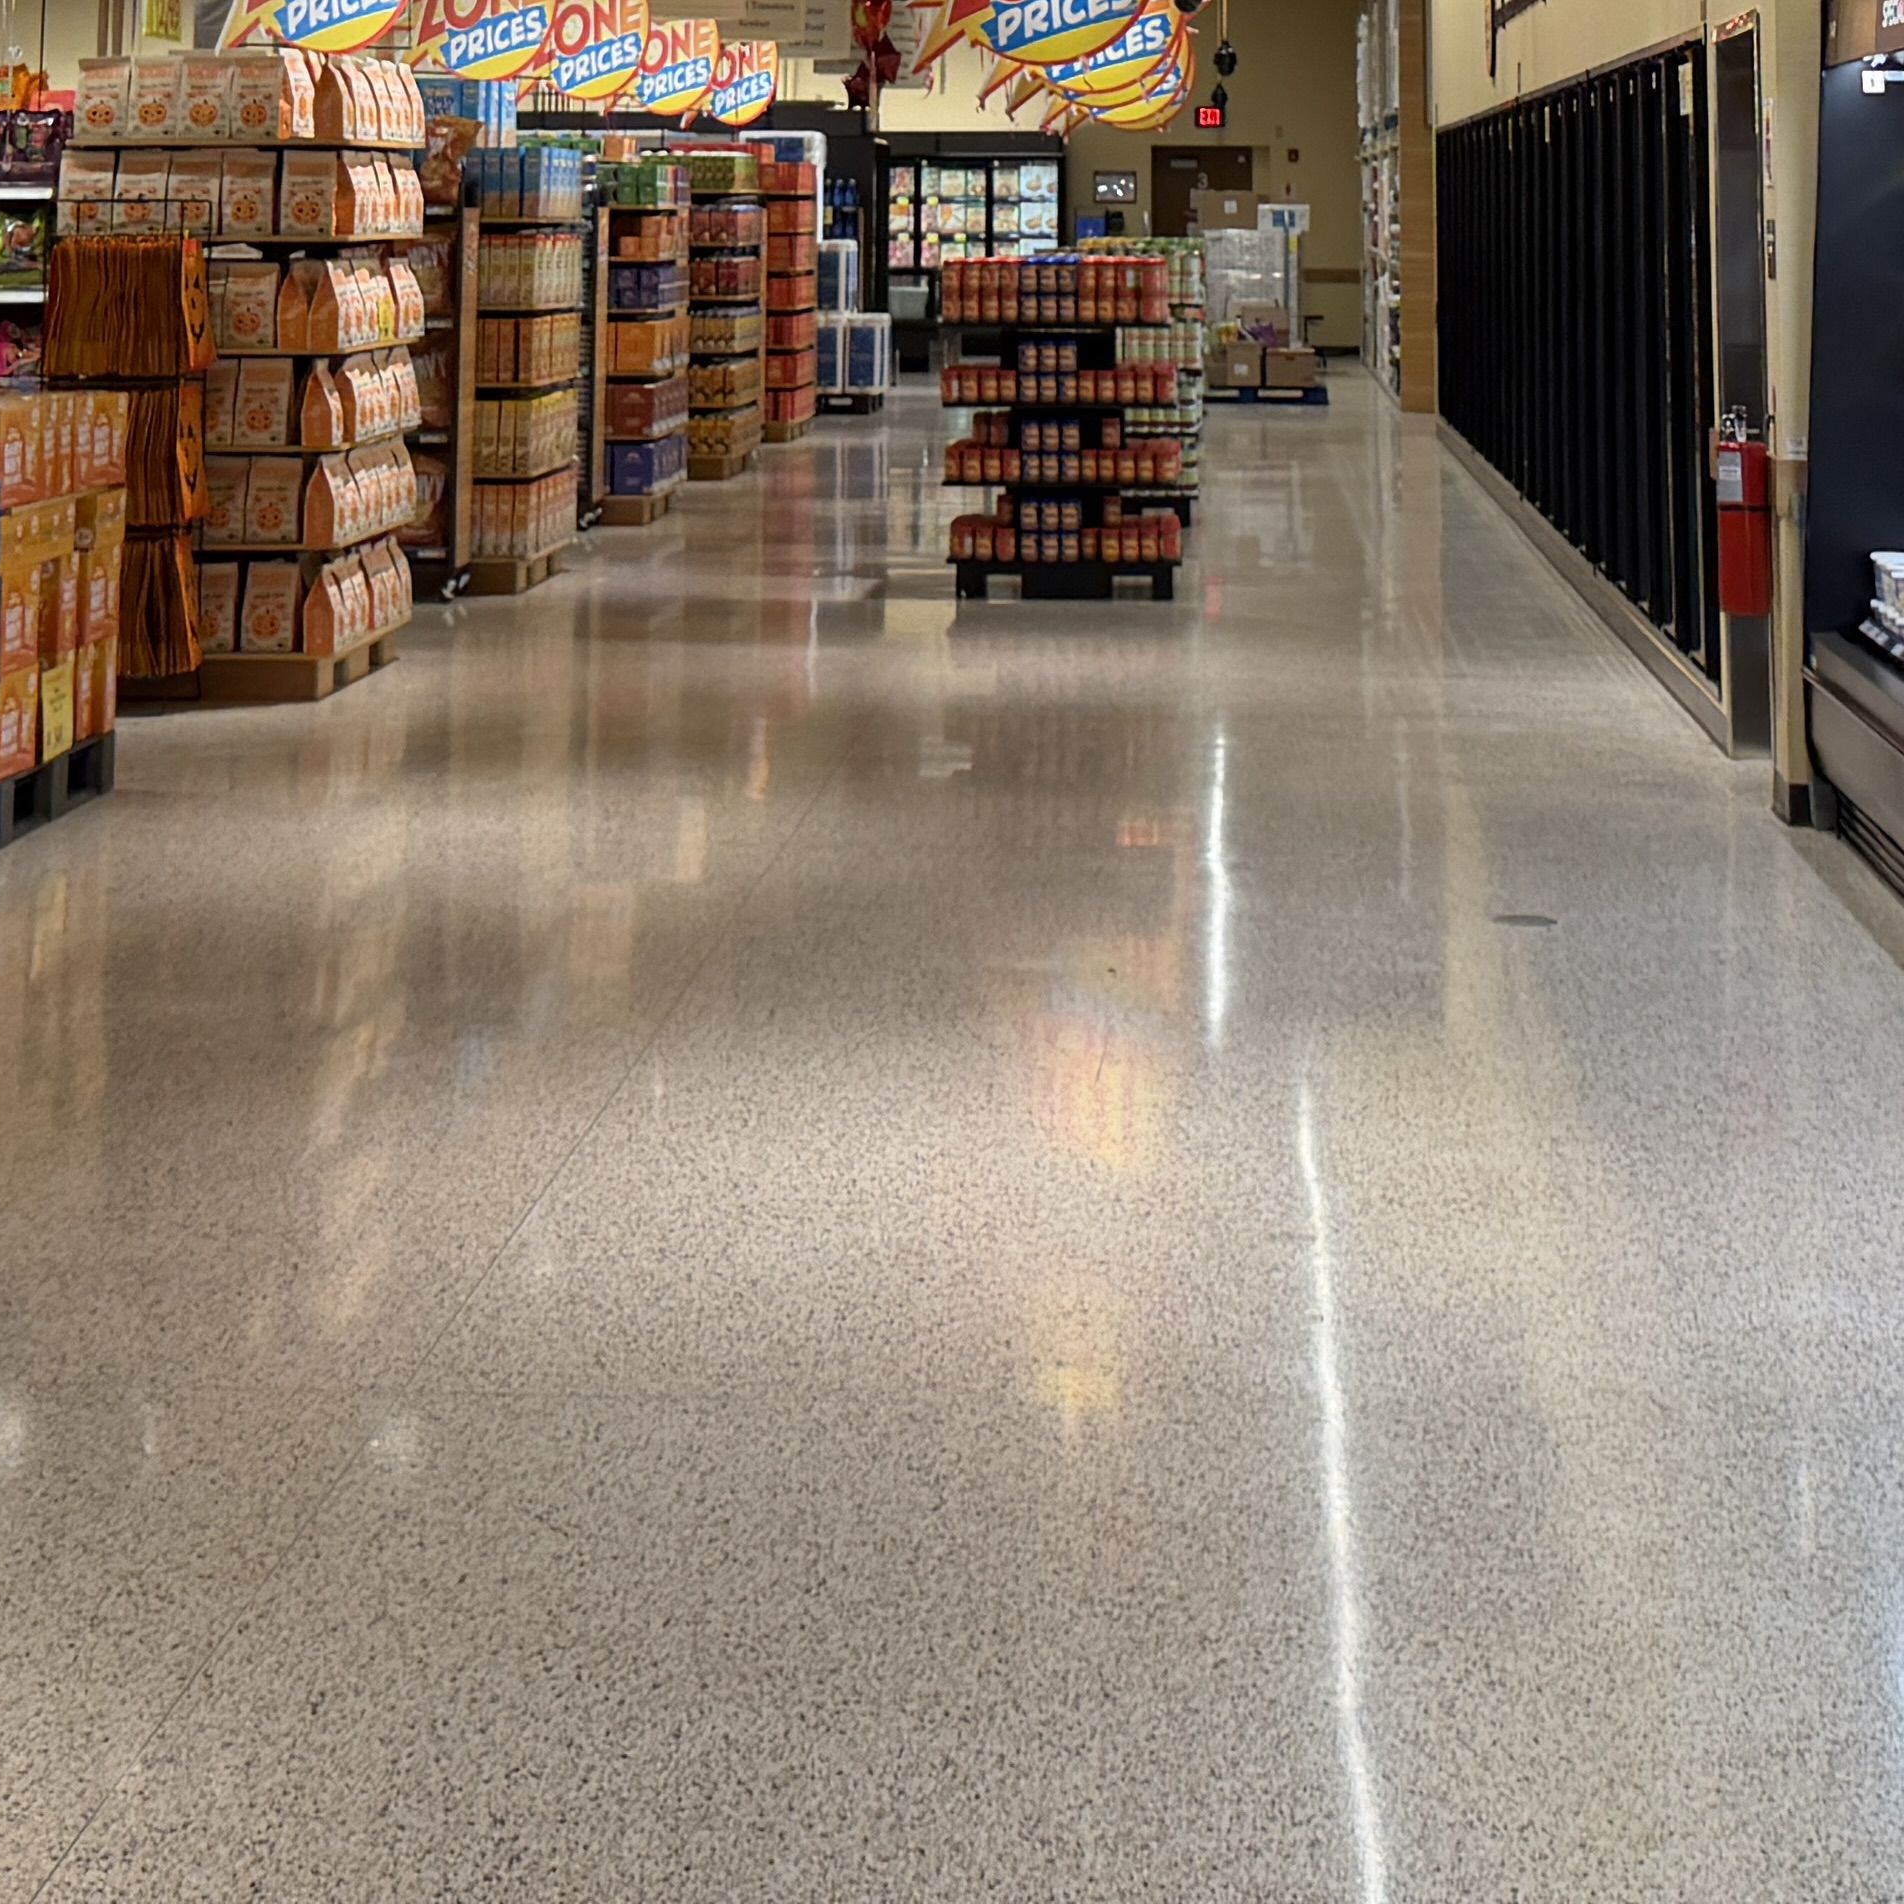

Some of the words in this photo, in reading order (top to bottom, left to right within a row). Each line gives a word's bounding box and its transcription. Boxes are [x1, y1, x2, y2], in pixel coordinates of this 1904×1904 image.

[447, 17, 547, 69] PRICES
[561, 37, 638, 88] PRICES
[643, 59, 708, 102] PRICES
[714, 75, 770, 116] PRICES
